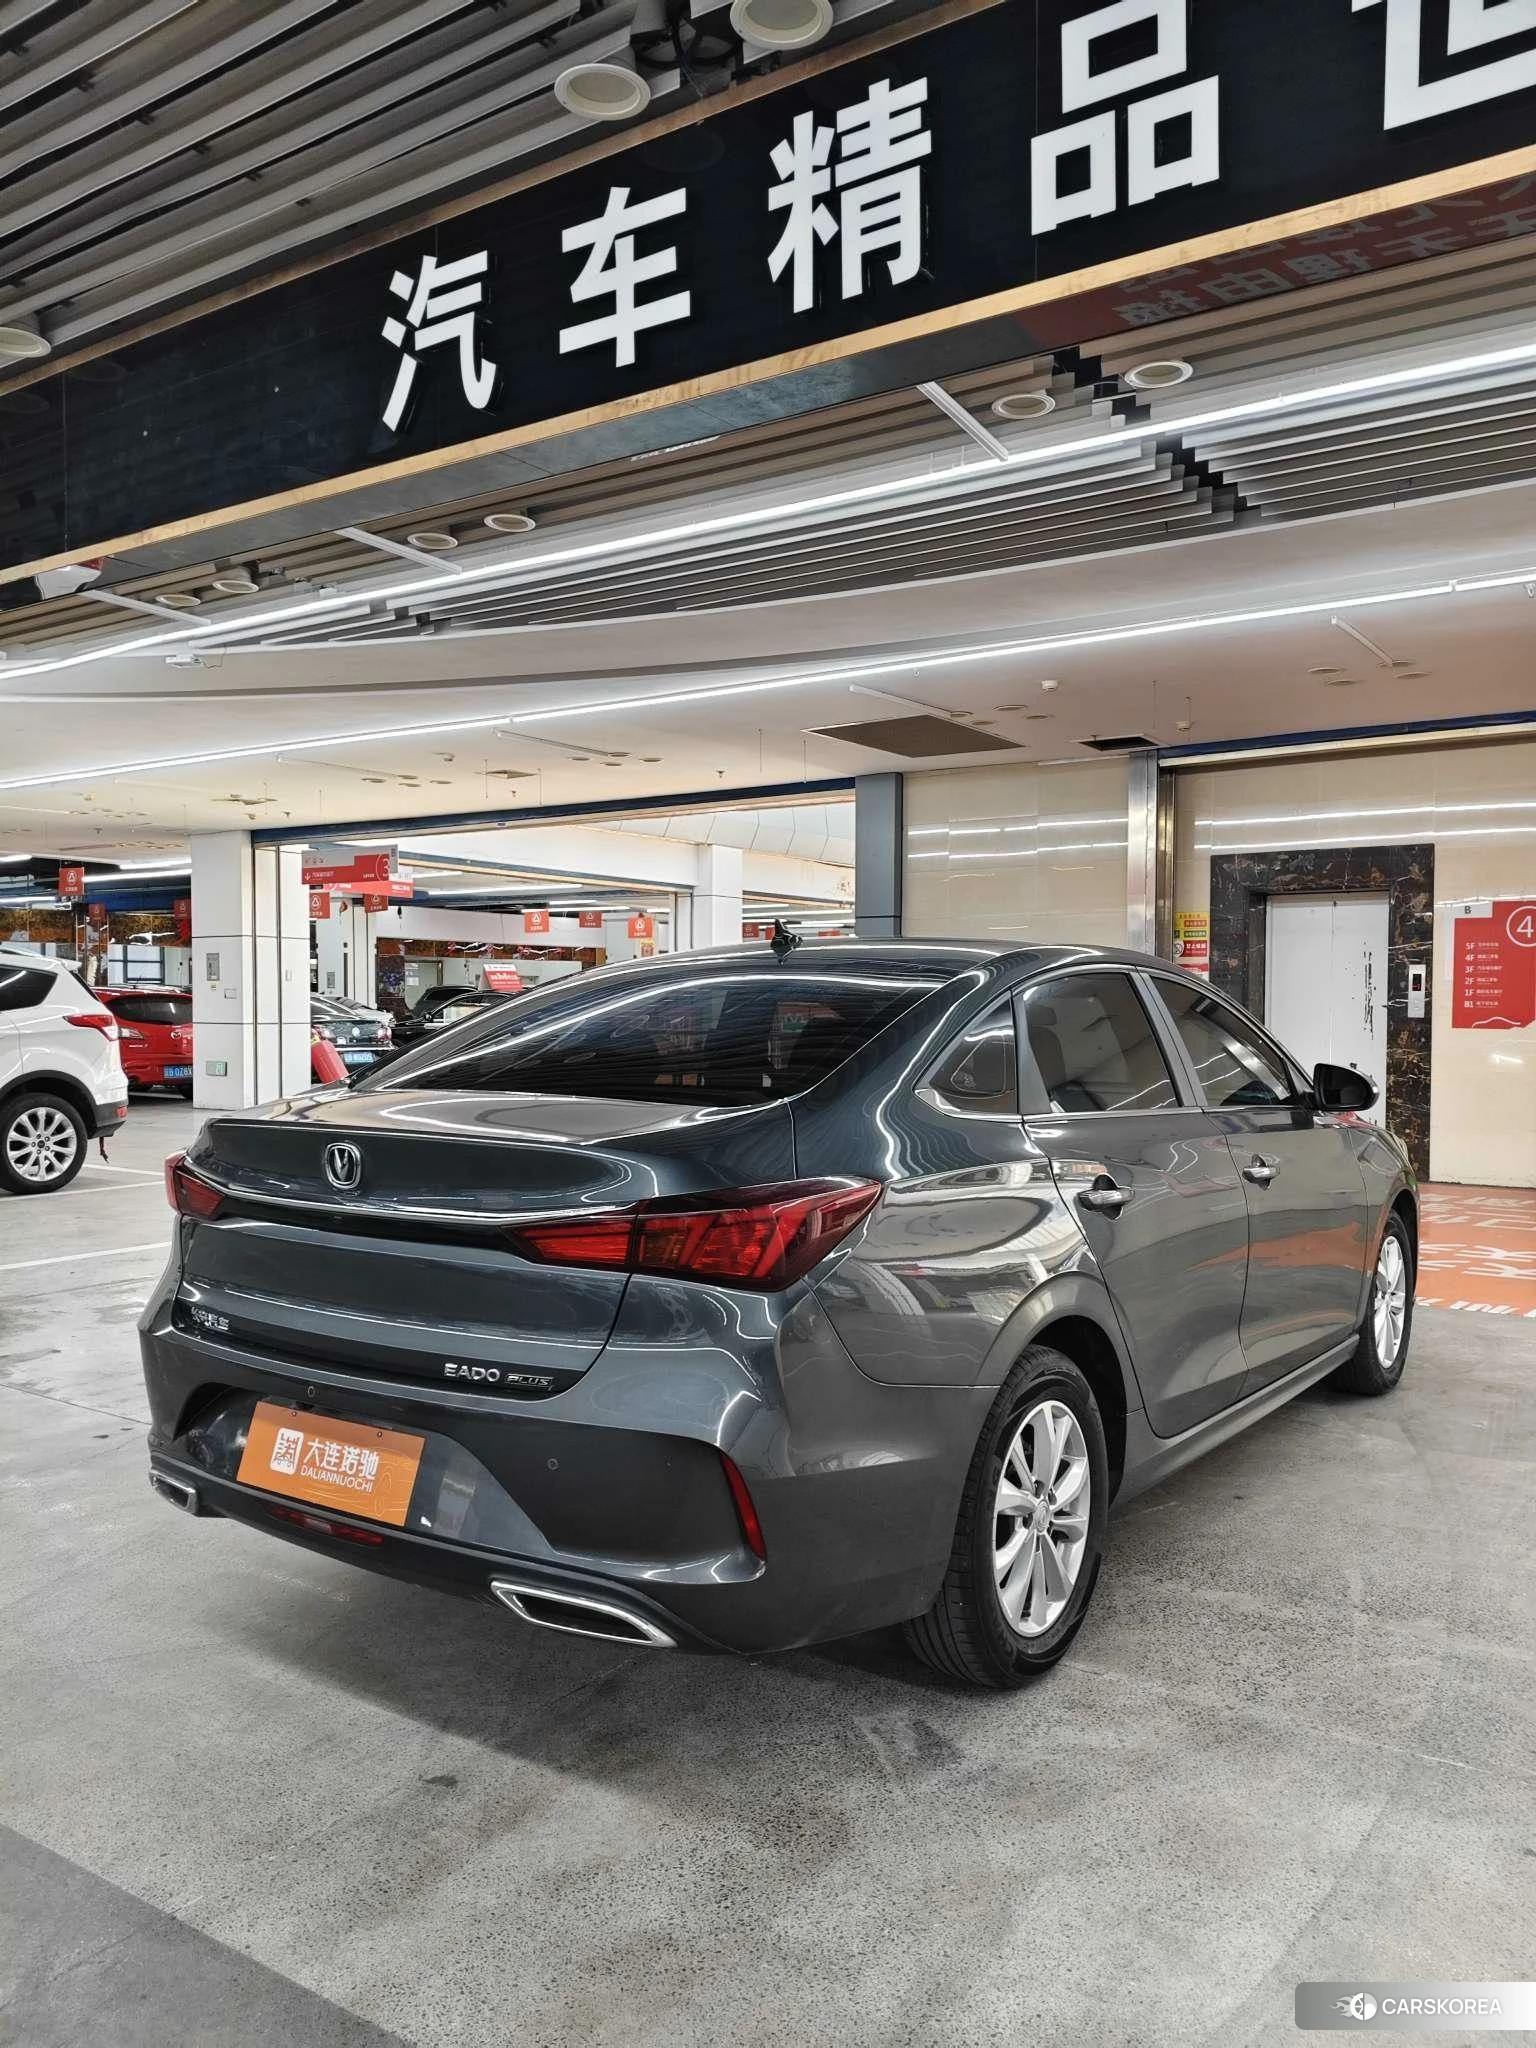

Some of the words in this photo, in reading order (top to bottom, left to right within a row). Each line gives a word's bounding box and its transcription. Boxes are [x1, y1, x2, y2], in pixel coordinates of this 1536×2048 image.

[1516, 915, 1535, 938] 4
[444, 1363, 500, 1381] EADO
[507, 1375, 550, 1387] PLUS
[303, 1438, 379, 1480] 大连诺驰
[300, 1464, 373, 1493] DALIANNUOCHI
